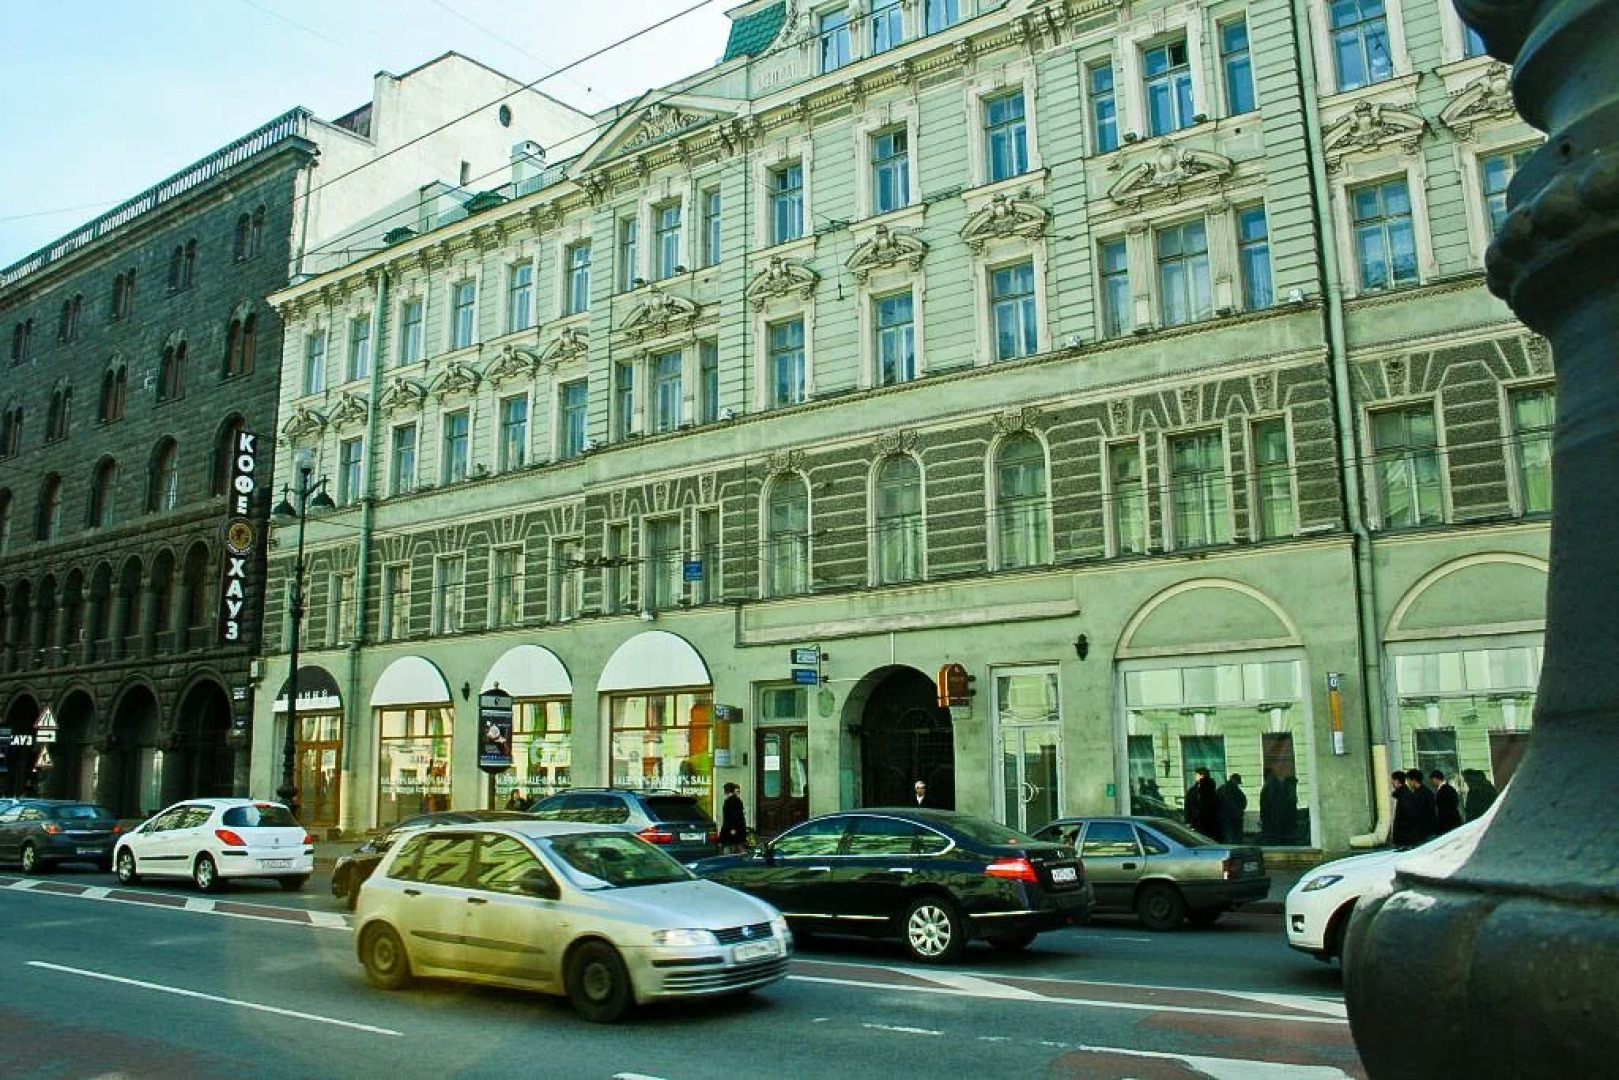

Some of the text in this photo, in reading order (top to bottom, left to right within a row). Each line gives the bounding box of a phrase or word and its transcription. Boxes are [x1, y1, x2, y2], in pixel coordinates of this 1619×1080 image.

[234, 432, 255, 515] КОФЕ
[225, 557, 246, 641] ХАУЗ
[690, 774, 712, 785] SALE
